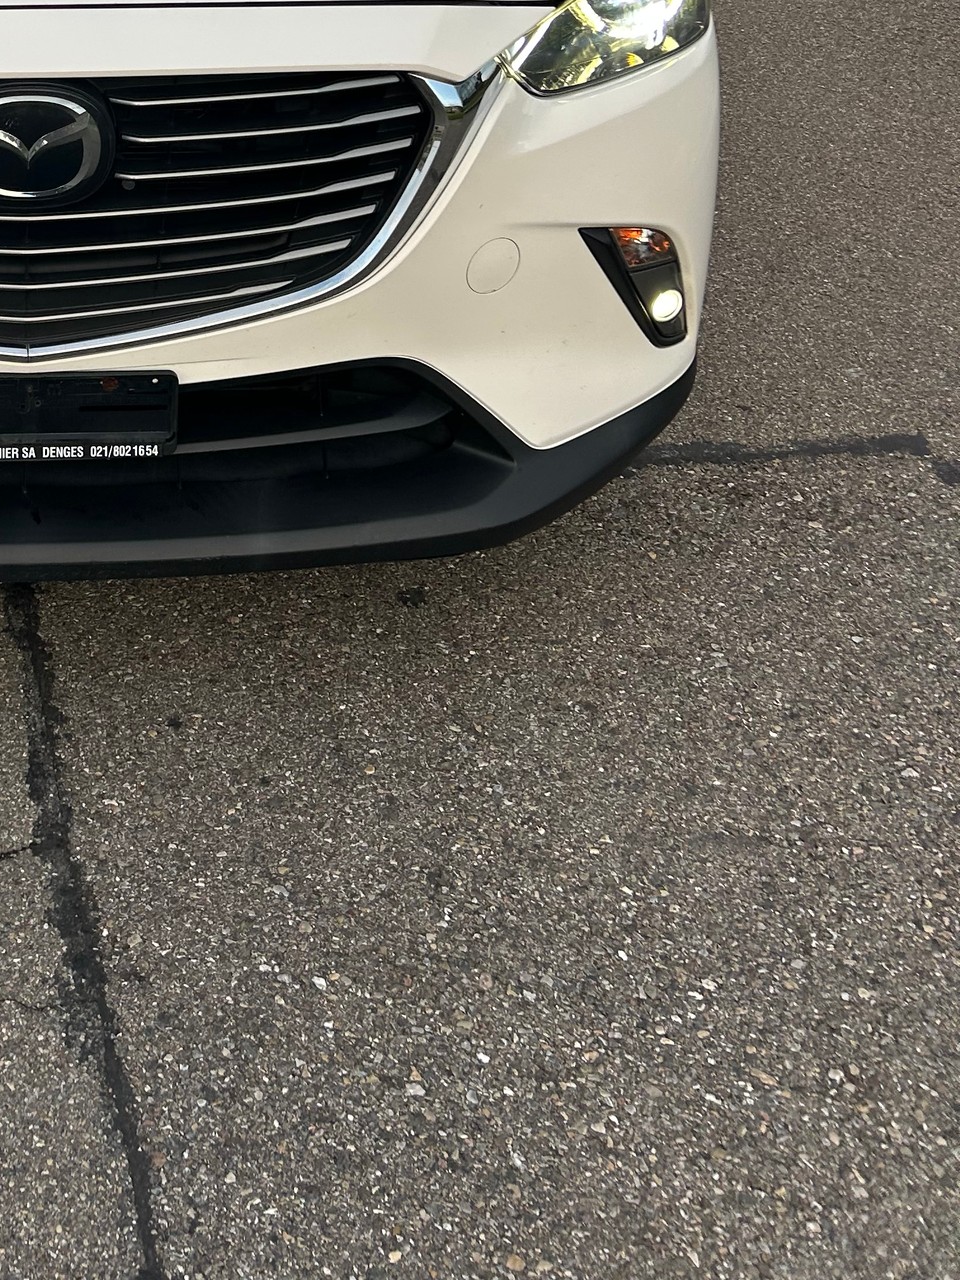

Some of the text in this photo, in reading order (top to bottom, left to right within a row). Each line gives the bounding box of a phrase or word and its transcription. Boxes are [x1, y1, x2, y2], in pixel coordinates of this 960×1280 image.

[22, 447, 36, 459] SA
[42, 446, 84, 458] DENGES
[90, 445, 159, 458] 021/8021654
